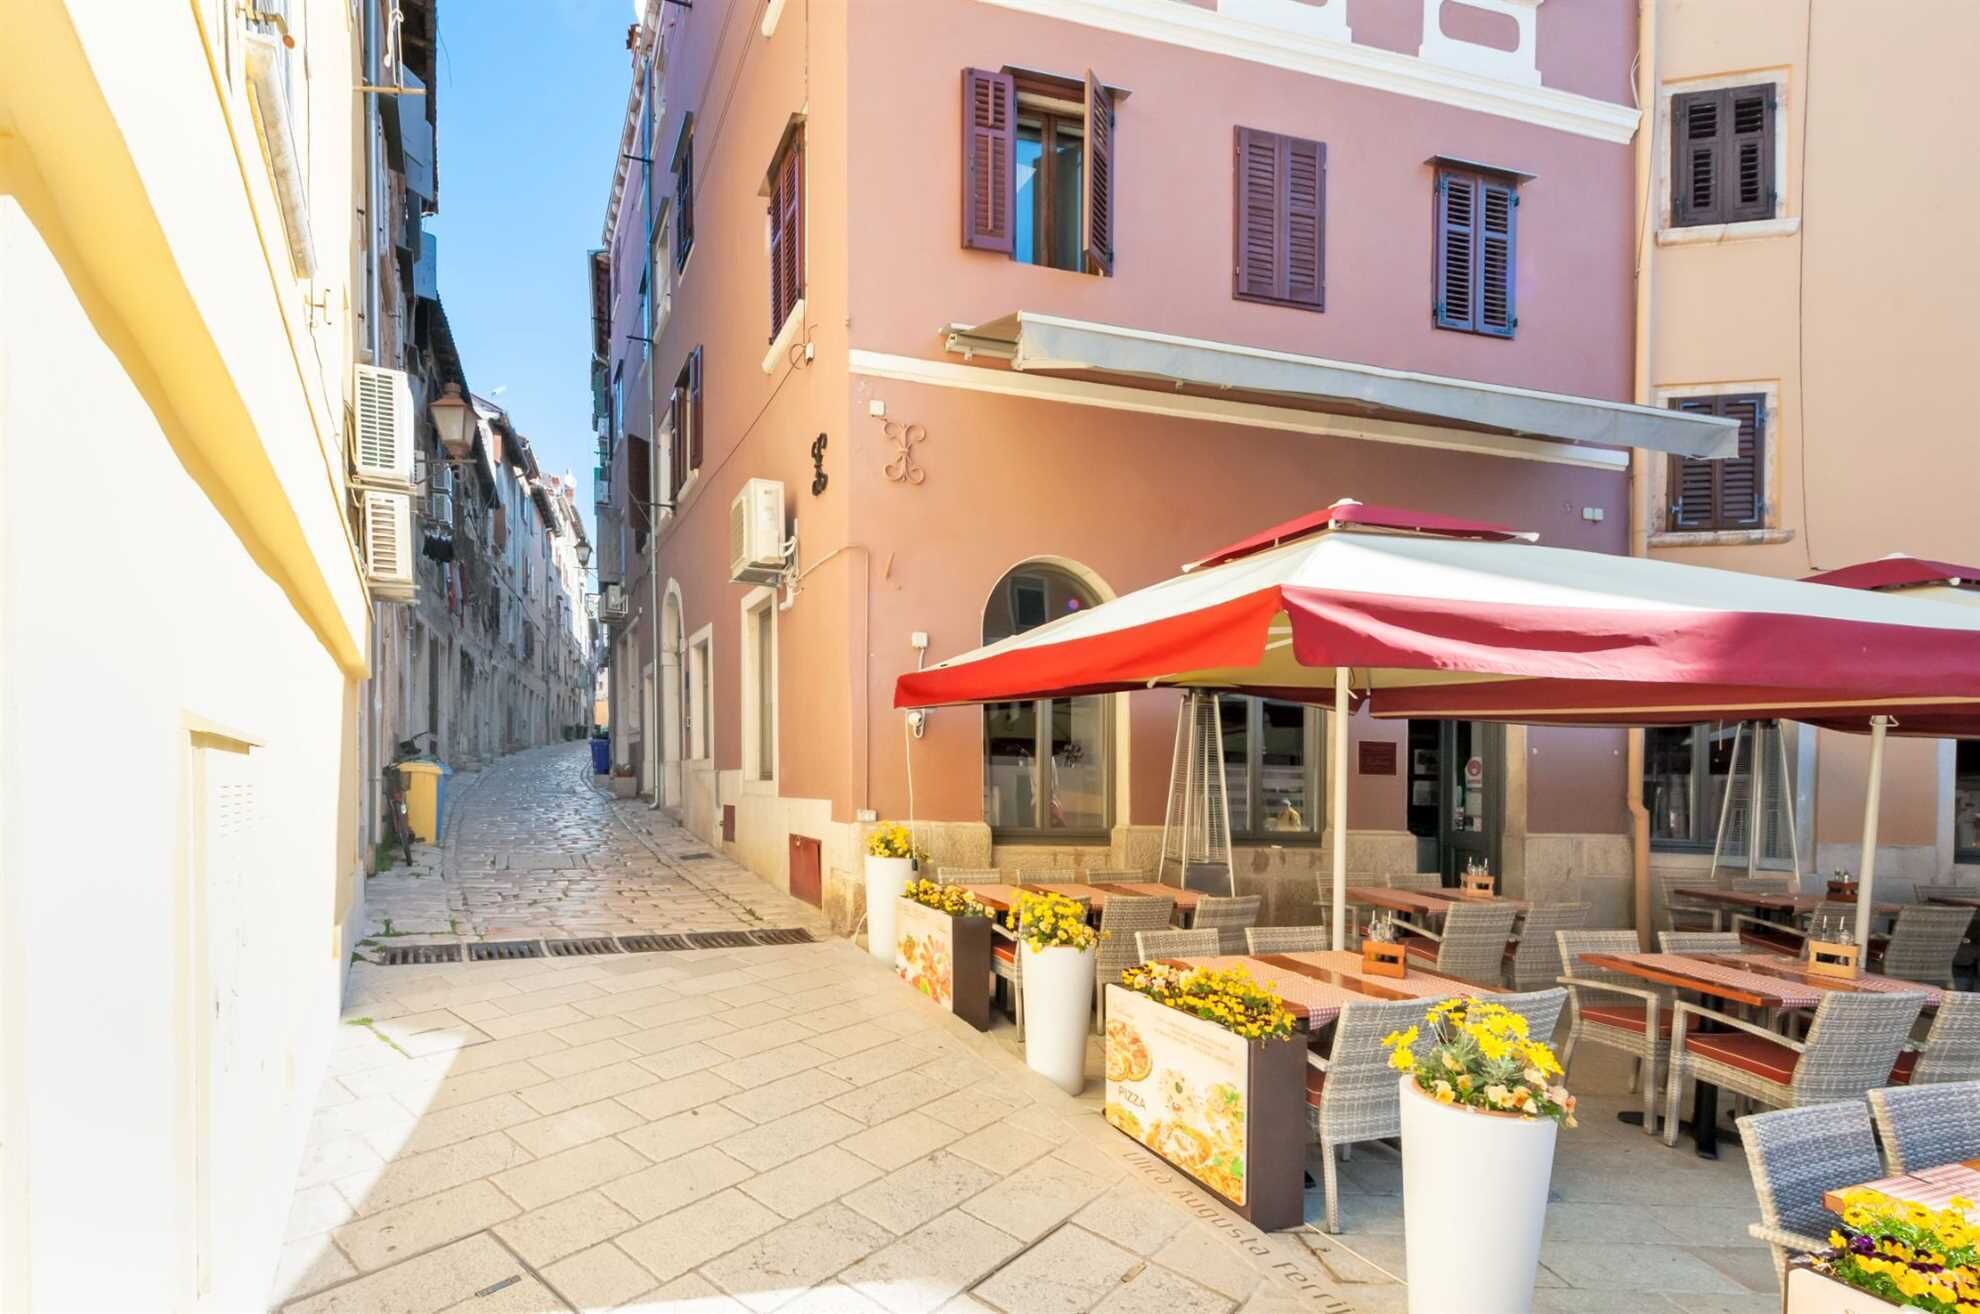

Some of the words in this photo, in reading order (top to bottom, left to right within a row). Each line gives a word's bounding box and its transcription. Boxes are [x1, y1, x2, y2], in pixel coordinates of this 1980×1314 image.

[1118, 1085, 1146, 1111] PIZZA
[1122, 1151, 1173, 1185] Ulica
[1171, 1189, 1270, 1256] Augusta
